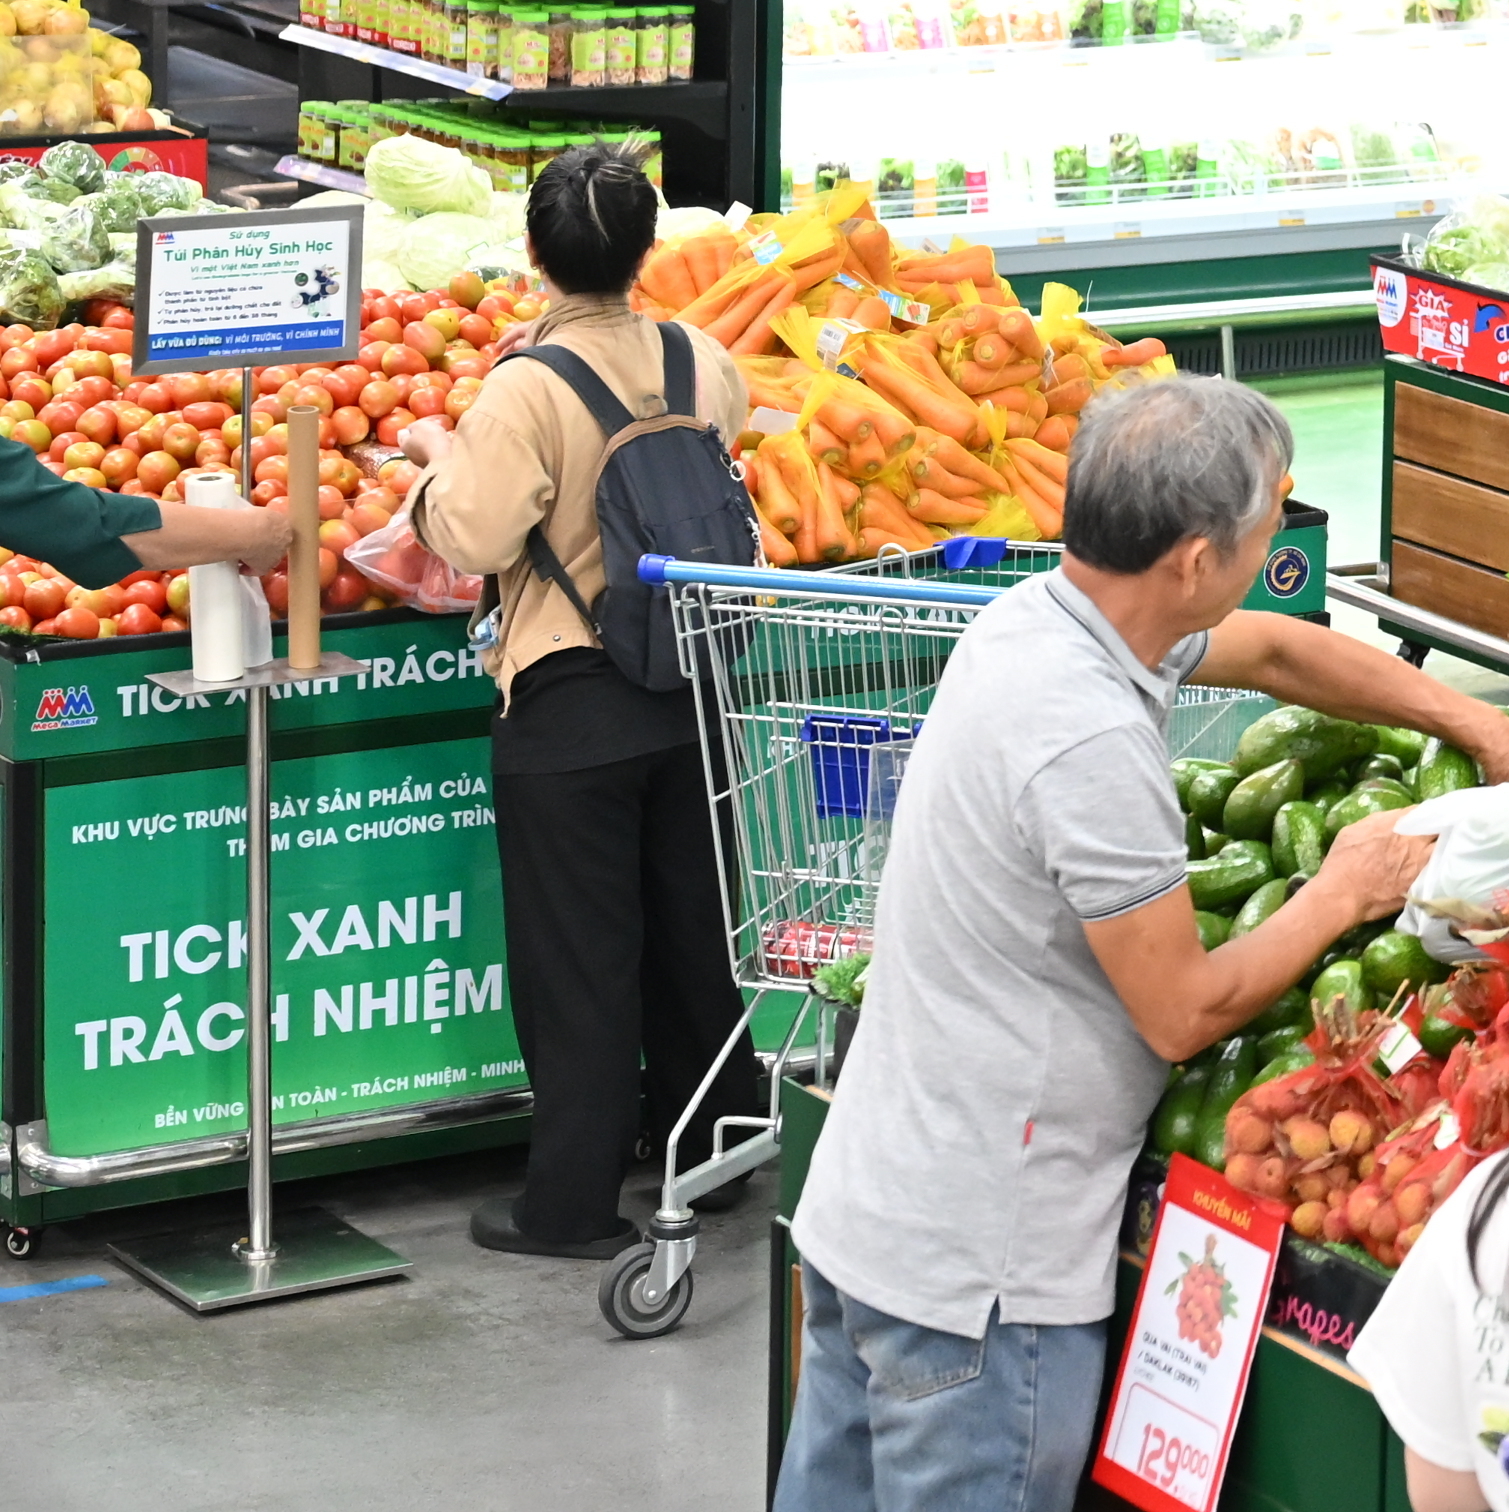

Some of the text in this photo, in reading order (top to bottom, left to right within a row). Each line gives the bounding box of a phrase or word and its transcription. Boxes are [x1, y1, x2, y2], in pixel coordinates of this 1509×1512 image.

[164, 240, 333, 261] Túi Phân Hủy Sinh Học
[72, 772, 486, 844] KHU VỰC SẢN PHẨM CỦA
[285, 890, 463, 960] XANH
[313, 959, 502, 1035] NHIỆM
[192, 1065, 467, 1123] VỮNG TOÀN TRÁCH NHIỆM
